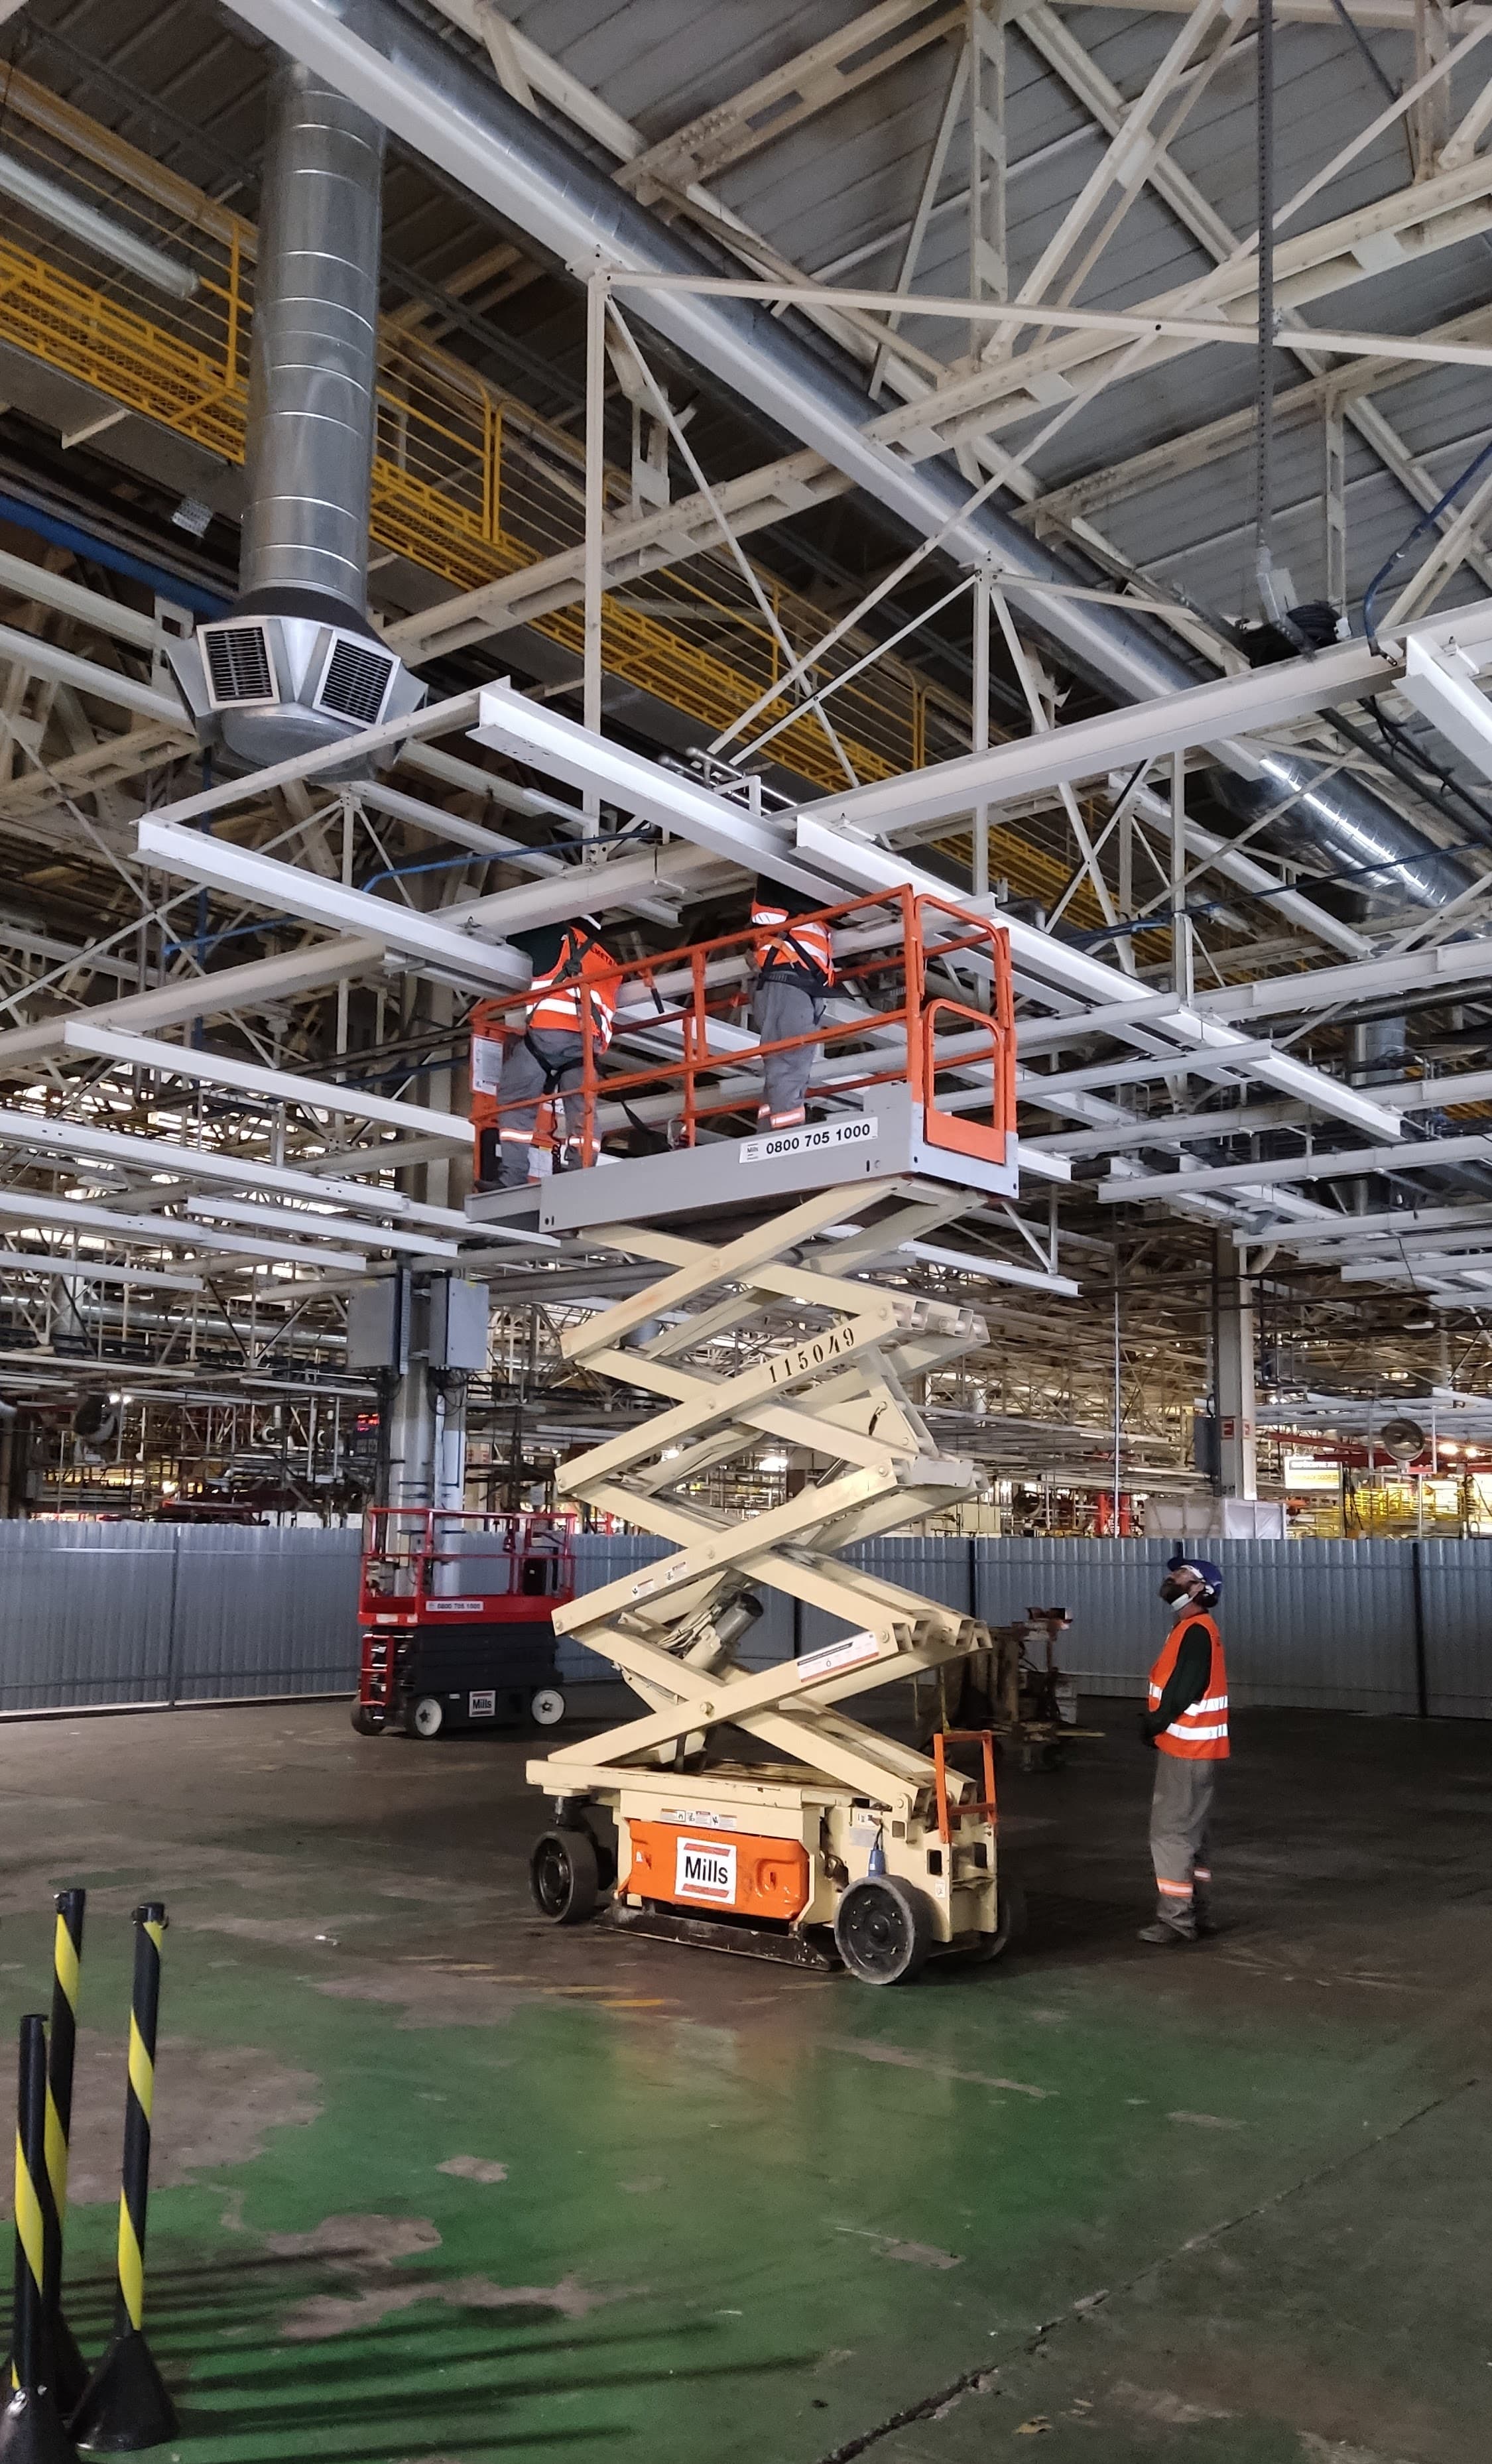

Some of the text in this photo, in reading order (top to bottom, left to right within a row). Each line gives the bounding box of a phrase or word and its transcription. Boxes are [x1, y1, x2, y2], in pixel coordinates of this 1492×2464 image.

[766, 1123, 871, 1154] 0800 705 1000
[769, 1327, 854, 1383] 115049
[472, 1698, 492, 1709] Mills
[685, 1856, 728, 1884] Mills
